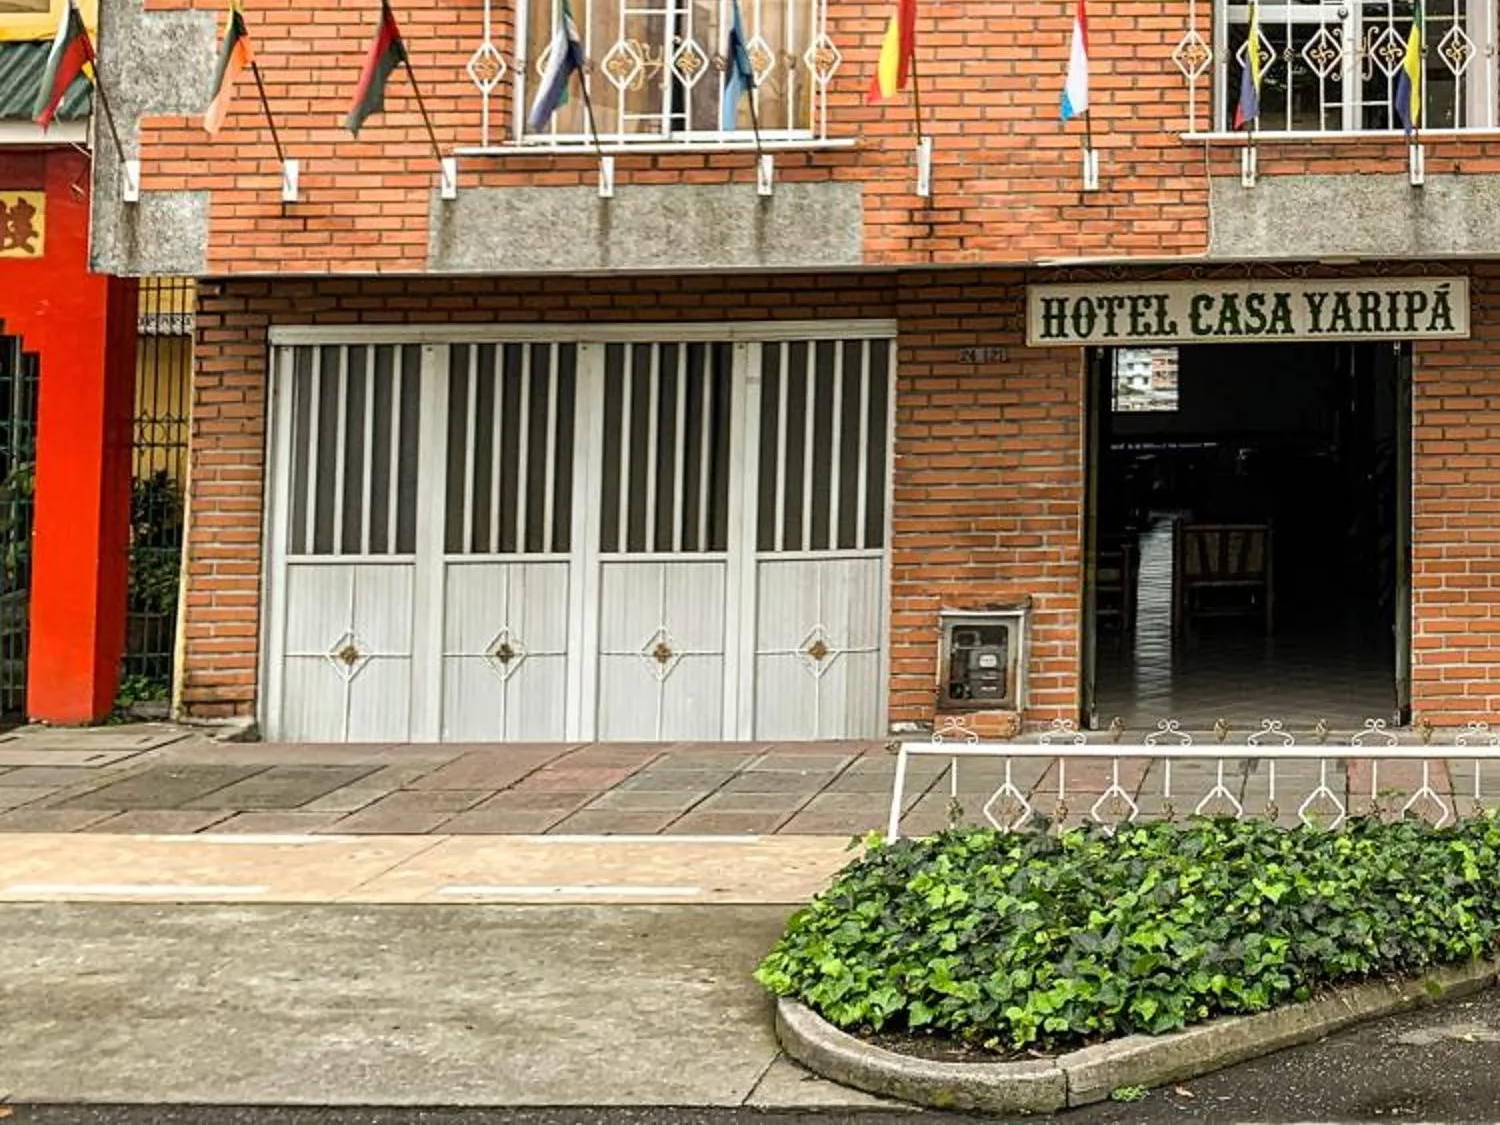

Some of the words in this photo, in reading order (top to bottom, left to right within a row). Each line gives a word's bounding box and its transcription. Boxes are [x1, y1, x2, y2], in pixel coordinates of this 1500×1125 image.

[1039, 293, 1179, 339] HOTEL
[1188, 291, 1296, 336] CASA
[1302, 282, 1455, 333] YARIPÁ
